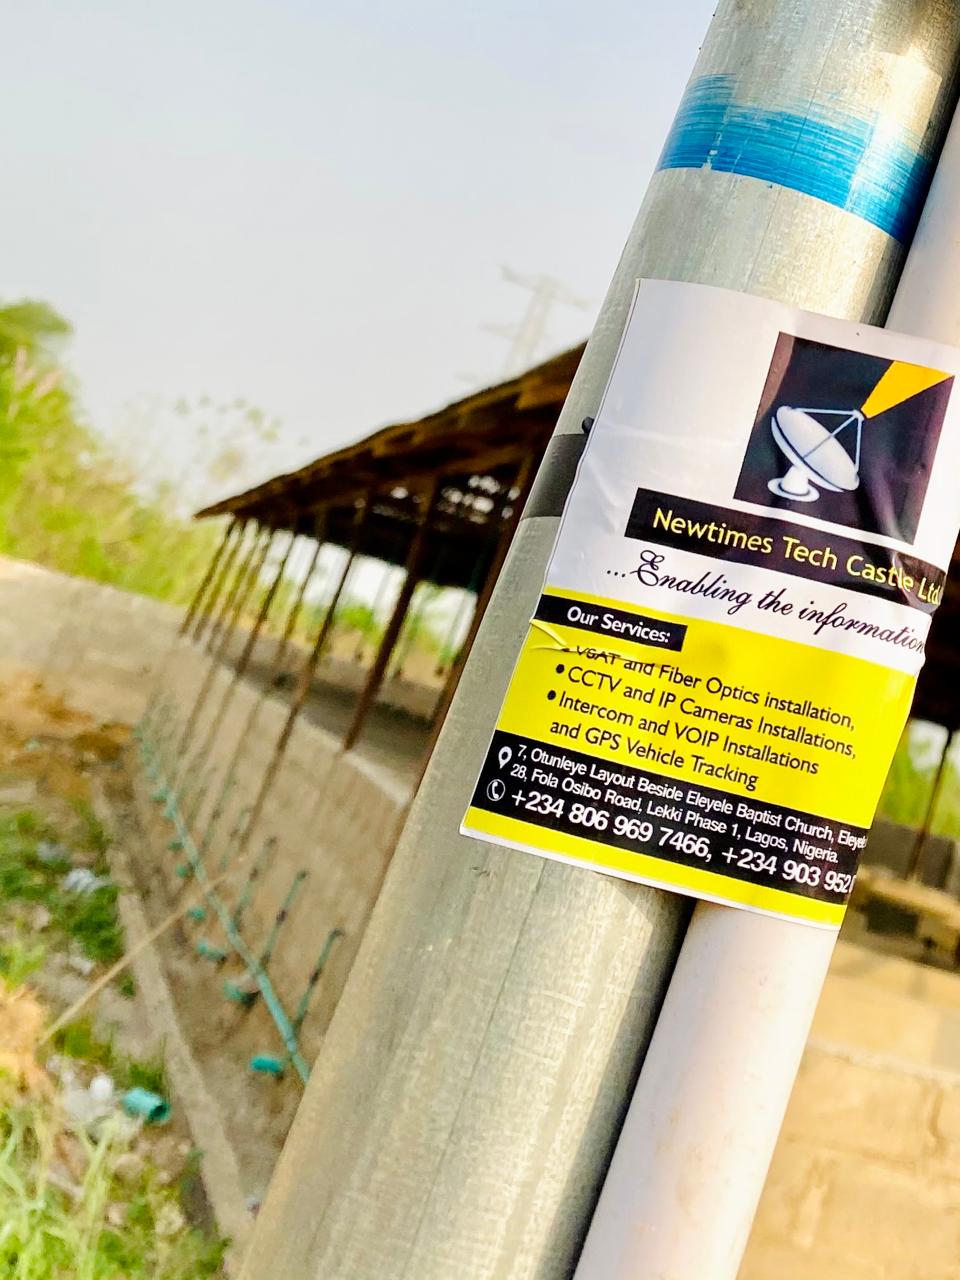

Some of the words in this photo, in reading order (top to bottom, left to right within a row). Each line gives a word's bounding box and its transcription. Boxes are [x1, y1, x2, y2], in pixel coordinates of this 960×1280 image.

[652, 507, 773, 554] Newtimes
[783, 536, 838, 571] Tech
[846, 554, 914, 593] Castle
[567, 606, 599, 626] Our
[601, 613, 671, 644] Services:
[757, 588, 794, 615] the
[798, 600, 925, 654] information
[559, 691, 634, 726] Intercom
[638, 718, 670, 736] and
[675, 722, 719, 747] VOIP
[723, 736, 819, 774] Installations
[568, 666, 622, 692] CCTV
[623, 686, 655, 704] and
[658, 691, 677, 708] IP
[680, 698, 753, 730] Cameras
[757, 716, 856, 759] Installations,
[623, 661, 656, 676] and
[659, 664, 702, 689] Fiber
[706, 676, 760, 705] Optics
[764, 692, 855, 731] installation,
[518, 744, 528, 761] 7,
[530, 748, 588, 779] Otunleye
[589, 764, 635, 789] Layout
[637, 777, 683, 801] Beside
[686, 790, 734, 815] Eleyele
[736, 803, 782, 828] Baptist
[784, 816, 835, 843] Church,
[550, 721, 582, 739] and
[585, 727, 622, 750] GPS
[627, 737, 685, 768] Vehicle
[691, 755, 759, 792] Tracking
[510, 763, 528, 782] 28,
[531, 769, 558, 788] Fola
[561, 778, 602, 801] Osibo
[604, 789, 643, 815] Road,
[647, 801, 683, 822] Lekki
[685, 811, 727, 834] Phase
[731, 823, 741, 840] 1,
[745, 827, 789, 853] Lagos,
[793, 839, 839, 863] Nigeria.
[511, 789, 565, 818] +234
[568, 803, 610, 831] 806
[612, 815, 653, 842] 969
[658, 826, 713, 862] 7466,
[721, 847, 777, 875] +234
[781, 860, 821, 887] 903
